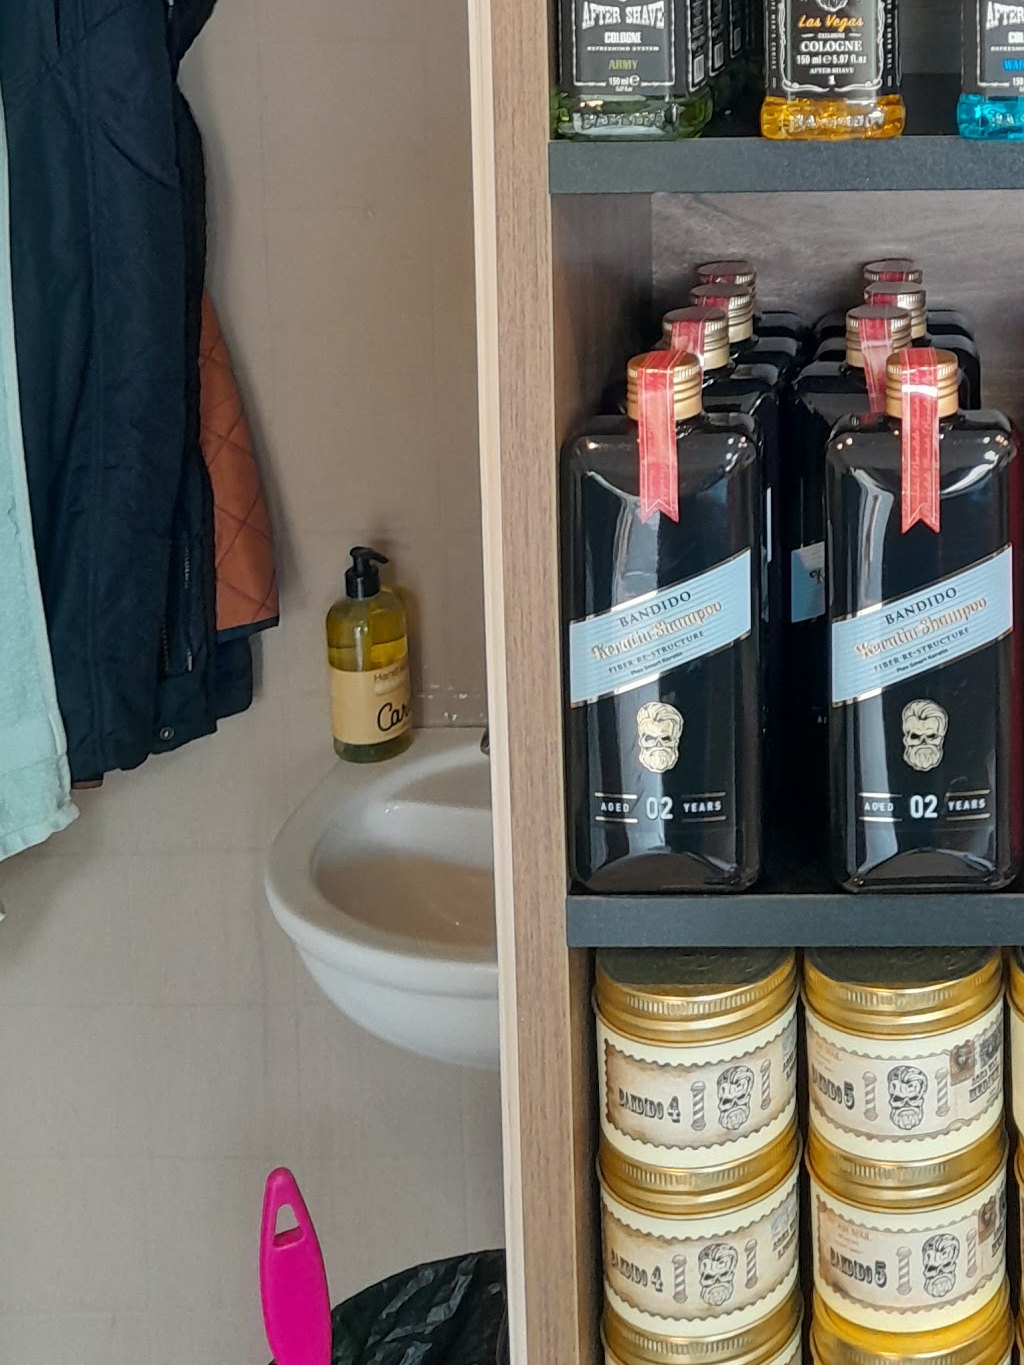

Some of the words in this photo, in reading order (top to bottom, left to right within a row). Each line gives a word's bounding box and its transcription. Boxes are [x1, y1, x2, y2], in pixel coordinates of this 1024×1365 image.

[582, 1, 621, 30] AFTER
[625, 1, 665, 30] SHAVE
[798, 14, 821, 28] Las
[825, 14, 864, 32] Vegas
[604, 31, 642, 44] COLOGNE
[801, 40, 862, 52] COLOGNE
[608, 59, 638, 71] ARMY
[797, 55, 811, 65] 150
[811, 55, 822, 65] ml
[832, 54, 849, 65] 5.07
[608, 77, 621, 86] 150
[828, 75, 836, 85] 1
[1013, 77, 1024, 86] 150
[619, 591, 691, 627] BANDIDO
[885, 587, 957, 625] BANDIDO
[609, 660, 633, 674] FIBER
[874, 657, 900, 671] FIBER
[601, 802, 629, 813] AGED
[646, 796, 673, 820] 02
[683, 801, 722, 813] YEARS
[864, 801, 894, 812] AGED
[910, 795, 938, 818] 02
[948, 798, 986, 811] YEARS
[844, 1080, 855, 1110] 5
[667, 1095, 681, 1123] 4
[651, 1265, 663, 1293] 4
[874, 1259, 887, 1289] 5
